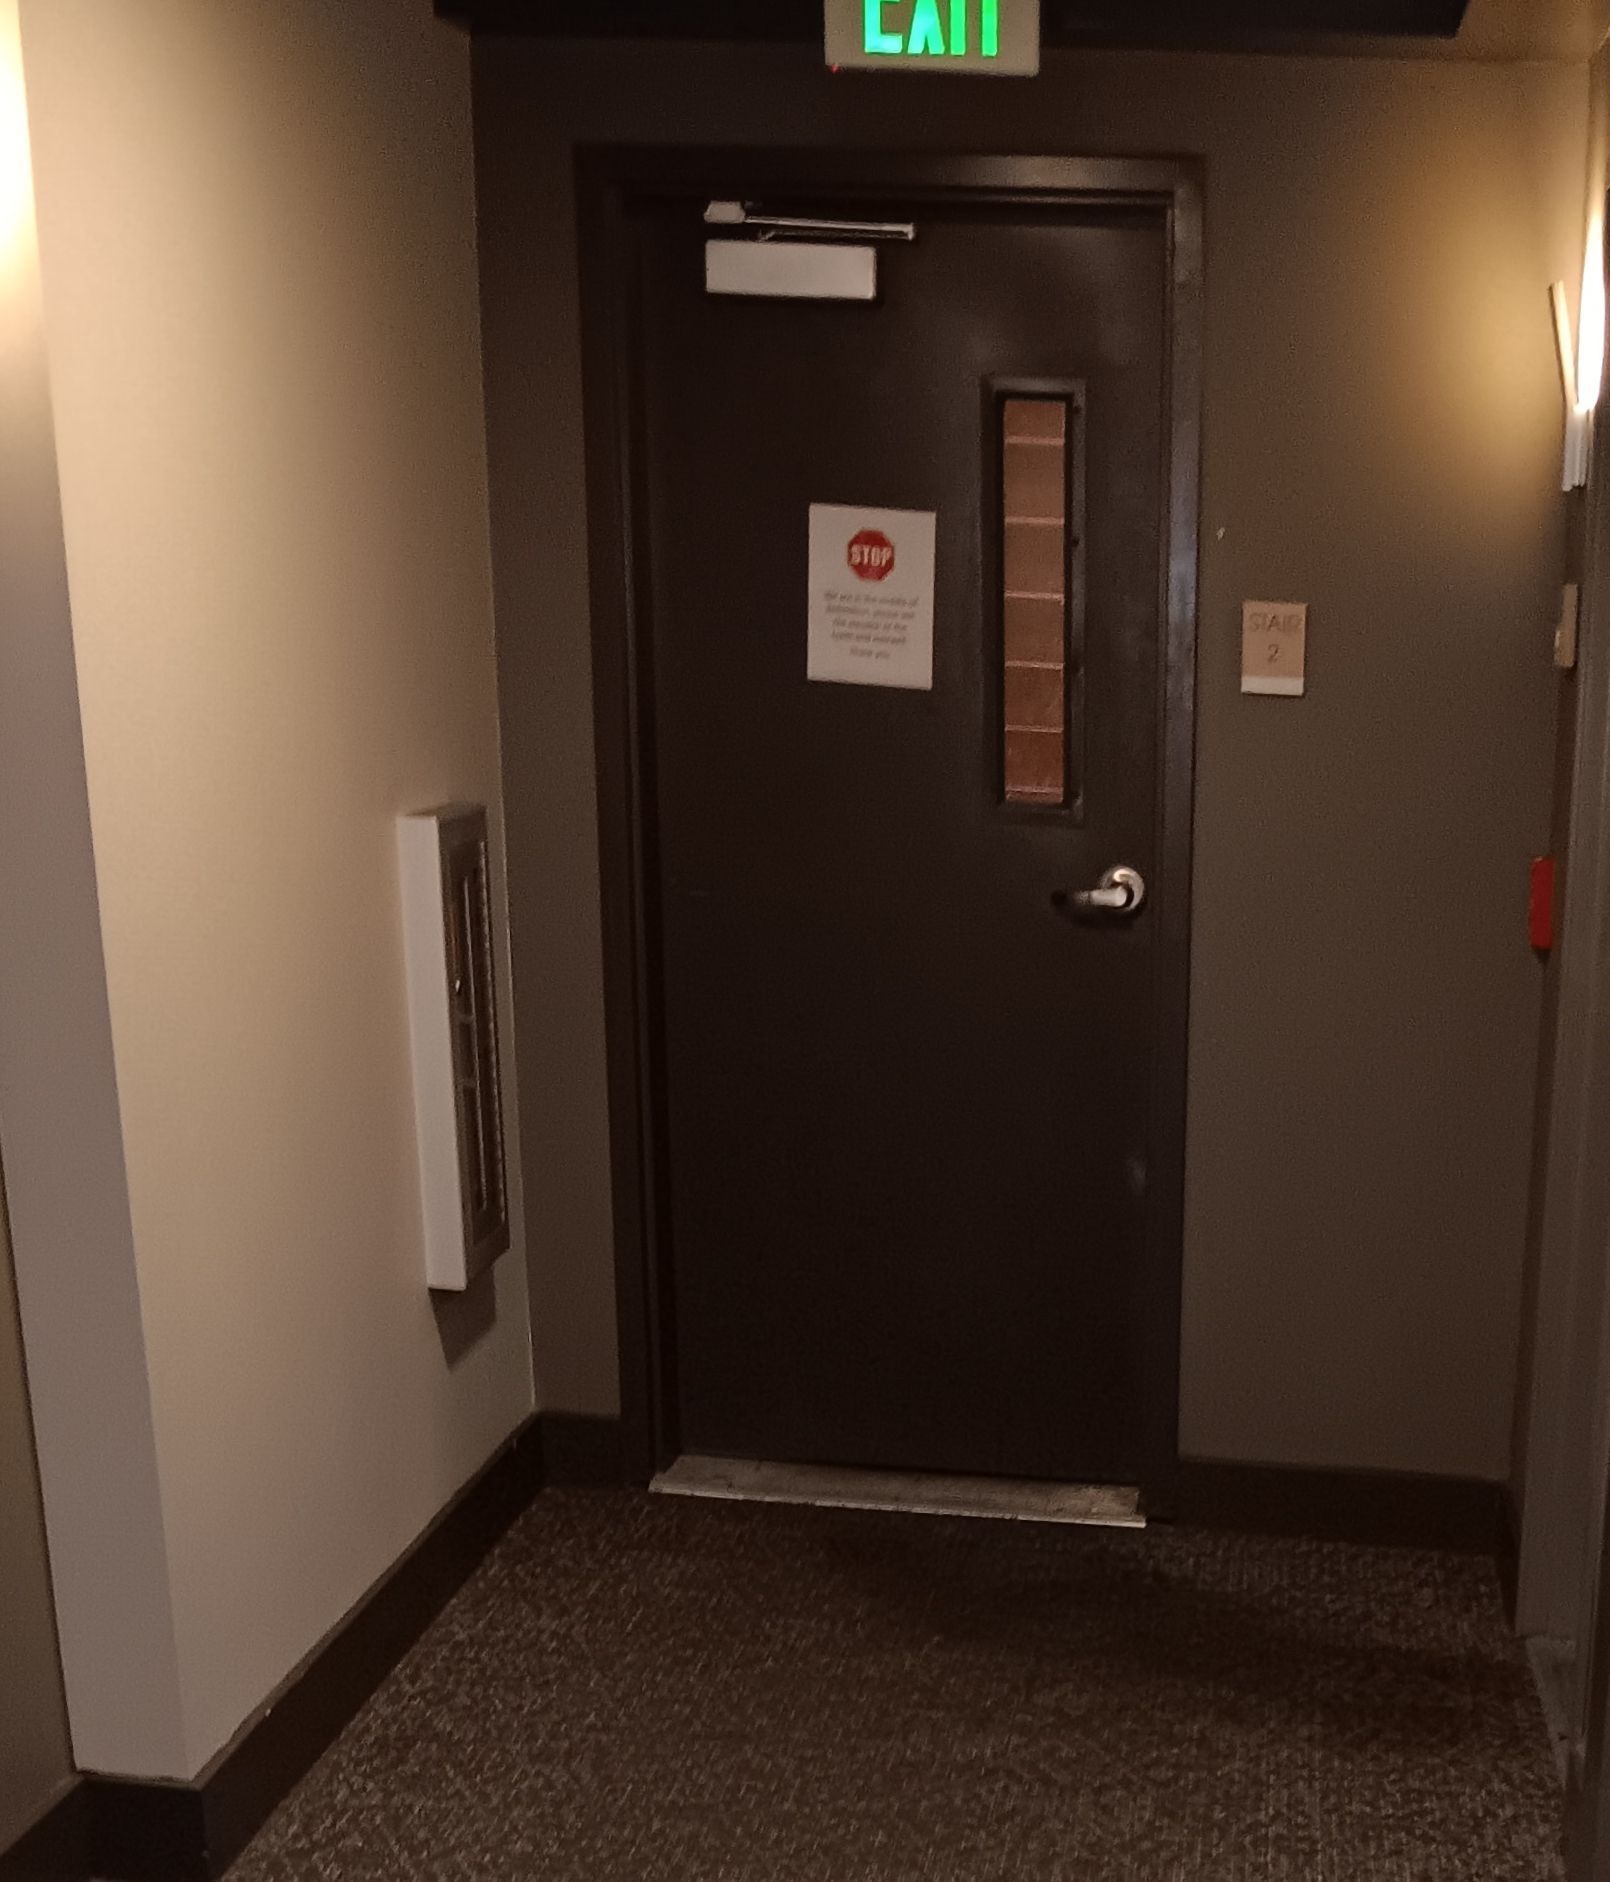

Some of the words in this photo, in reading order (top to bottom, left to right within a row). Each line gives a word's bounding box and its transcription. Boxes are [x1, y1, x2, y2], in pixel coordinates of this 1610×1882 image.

[849, 543, 892, 567] STOP
[1248, 612, 1302, 633] STAIR
[1267, 643, 1280, 663] 2
